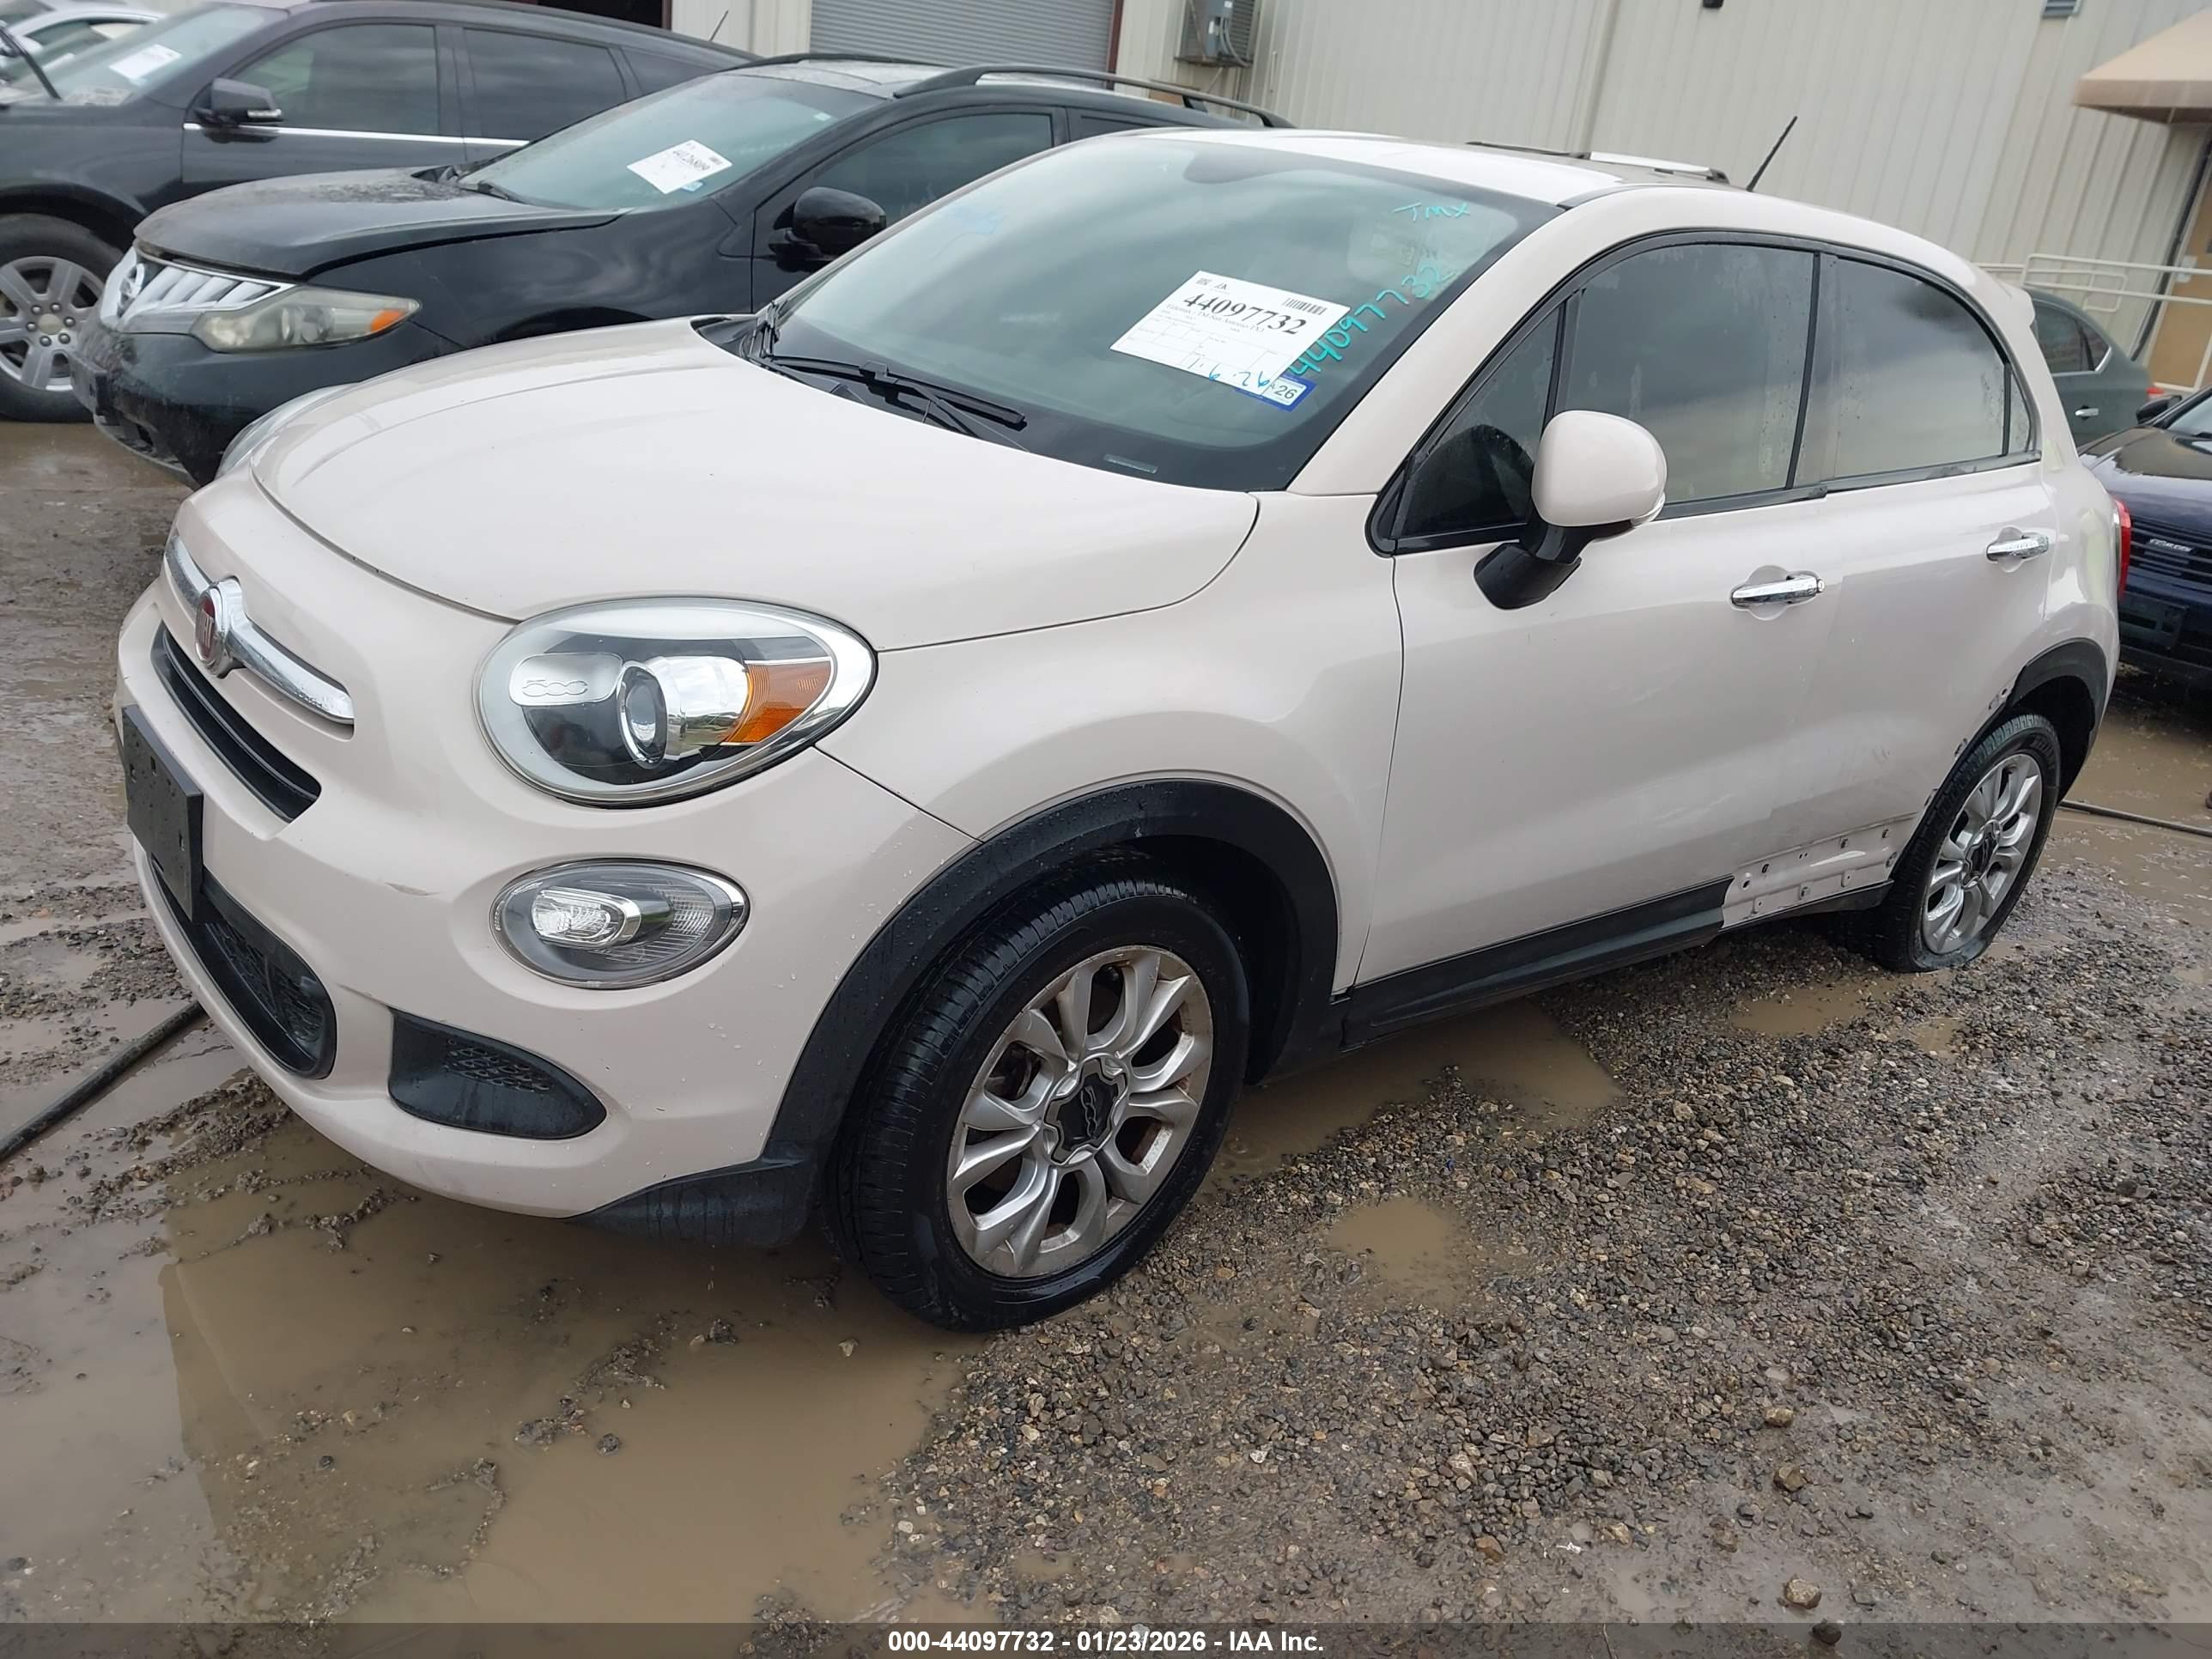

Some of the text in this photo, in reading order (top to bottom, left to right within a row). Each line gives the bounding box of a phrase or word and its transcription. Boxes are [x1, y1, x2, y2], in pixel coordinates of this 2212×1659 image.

[1183, 293, 1308, 335] 44097732
[1288, 264, 1455, 375] 44097732
[1274, 385, 1297, 399] 26
